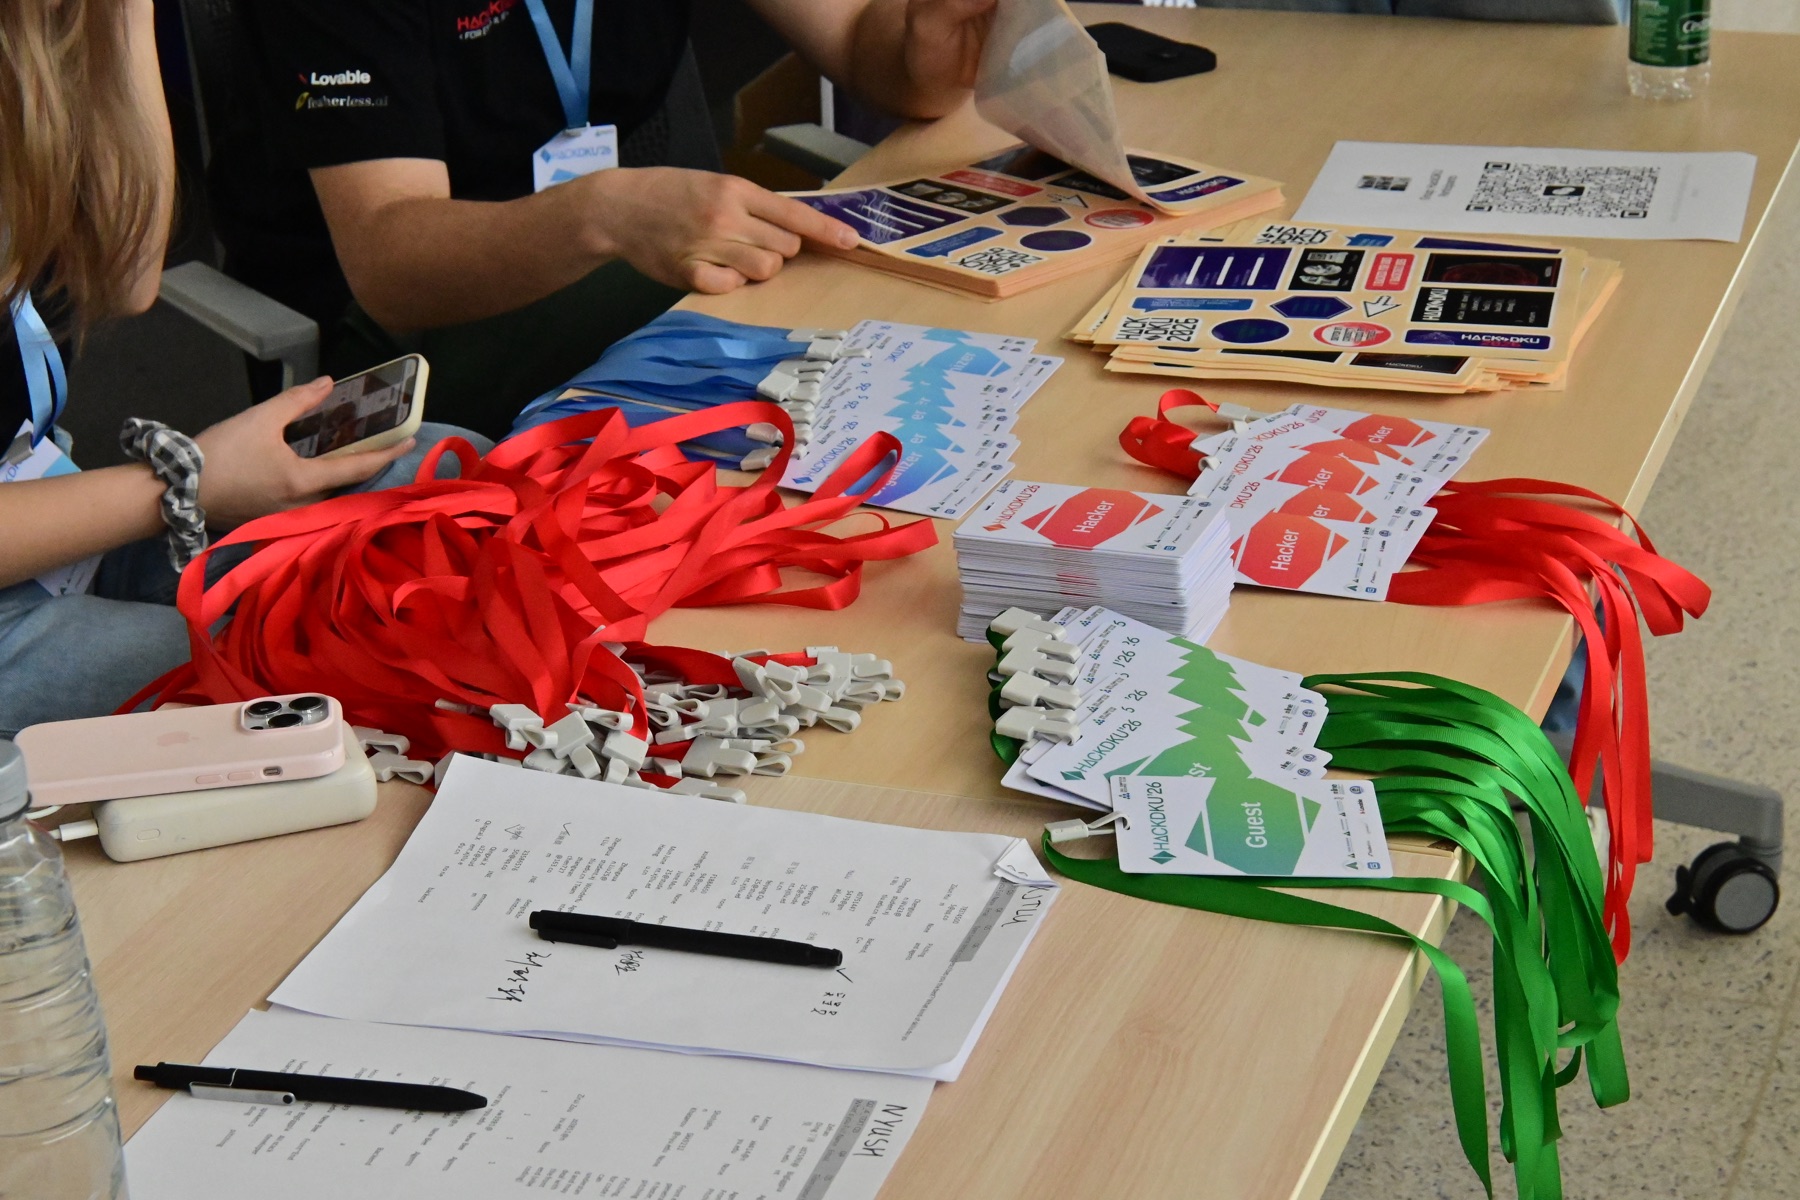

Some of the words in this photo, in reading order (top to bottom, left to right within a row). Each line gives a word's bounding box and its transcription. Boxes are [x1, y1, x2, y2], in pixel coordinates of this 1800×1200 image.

[311, 69, 371, 85] Lovable
[1115, 317, 1149, 341] HACK
[1167, 318, 1199, 342] 2026
[1072, 500, 1115, 534] Hacker
[1270, 529, 1299, 571] Hacker
[1073, 718, 1142, 773] HACKDKU'26
[1145, 781, 1170, 851] HACKDKU'26
[1240, 801, 1268, 849] Guest
[853, 1104, 908, 1159] NYUSH
